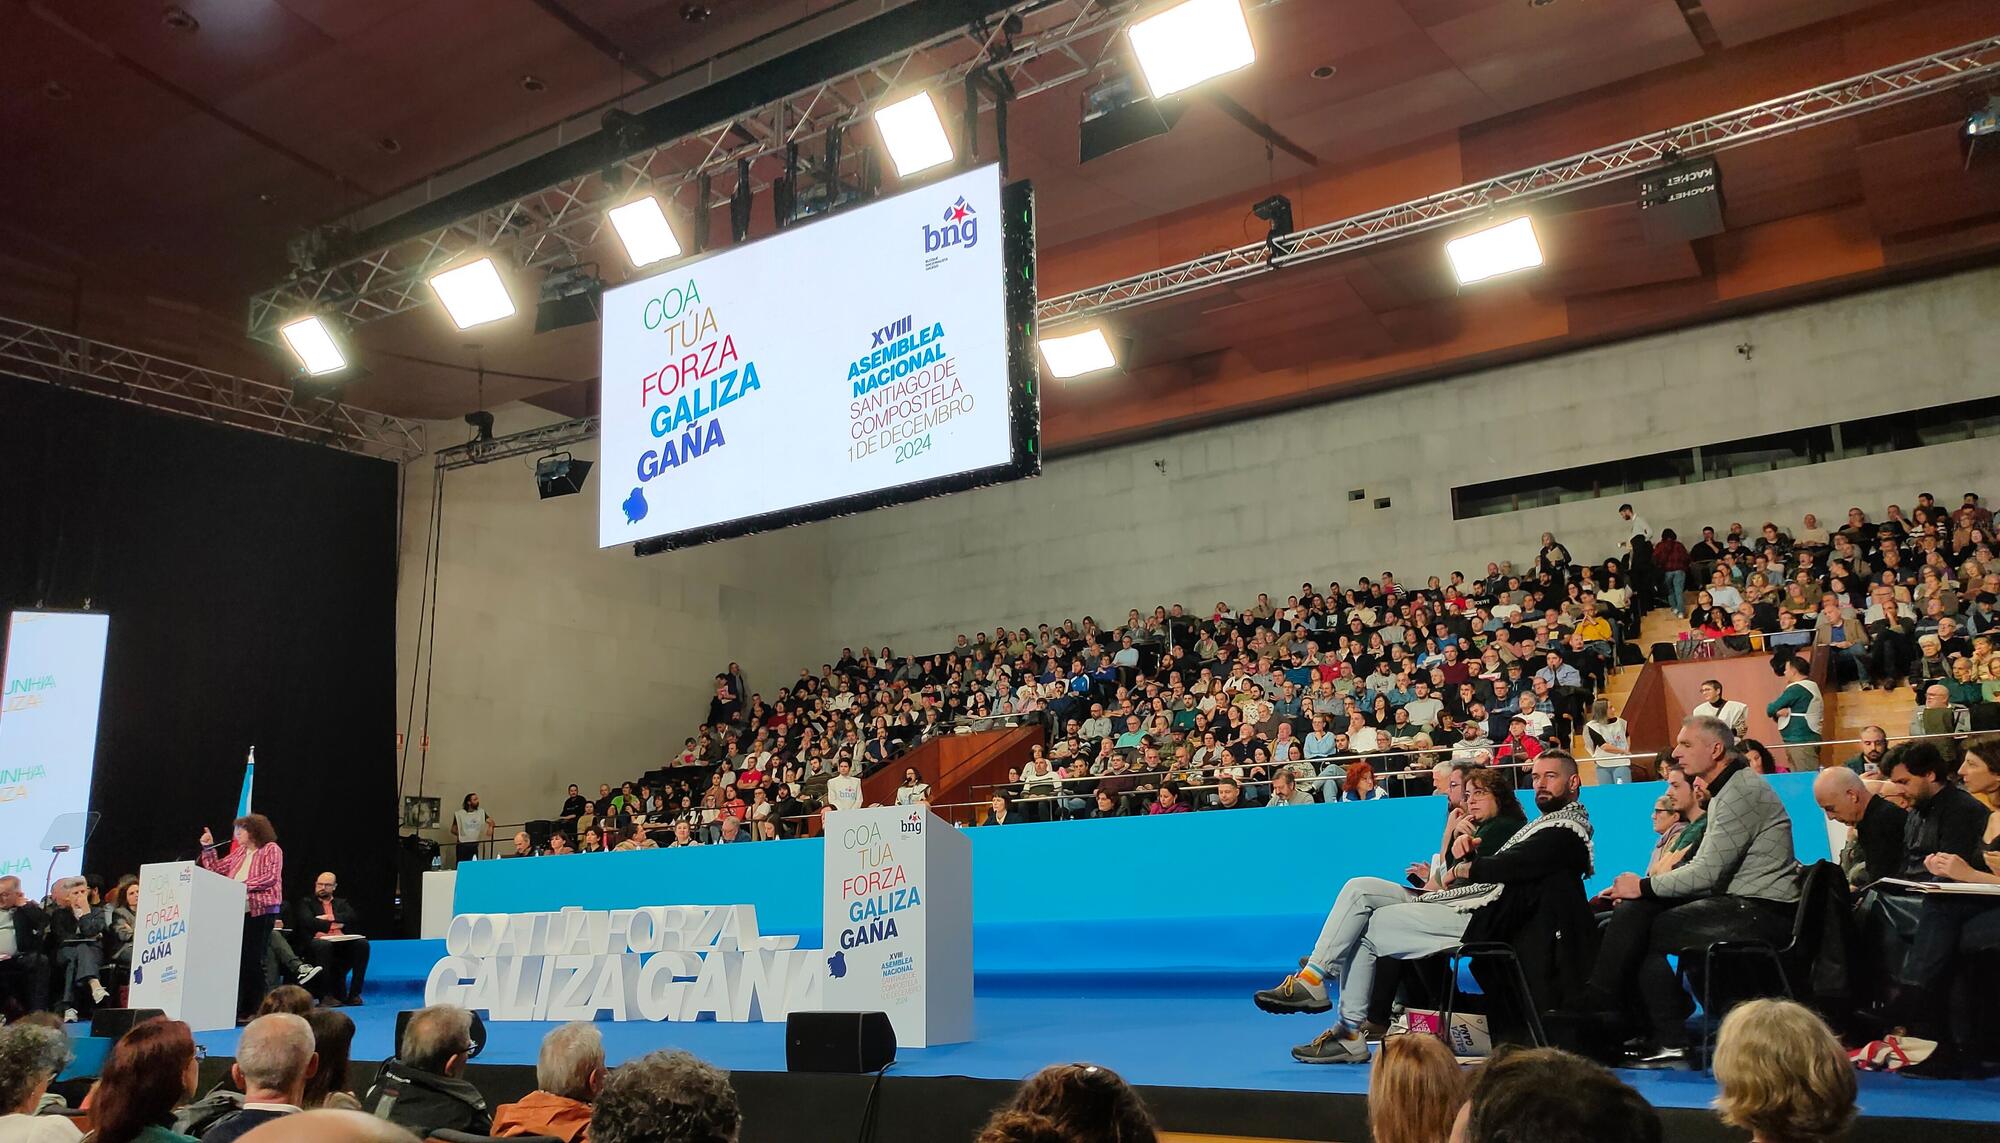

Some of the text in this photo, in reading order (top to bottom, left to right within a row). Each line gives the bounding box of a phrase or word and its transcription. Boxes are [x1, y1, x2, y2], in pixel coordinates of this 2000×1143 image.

[1666, 167, 1713, 187] KACHET
[1668, 184, 1715, 202] KACHET
[922, 217, 978, 253] bng
[643, 278, 701, 330] COA
[664, 306, 718, 356] TÚA
[870, 314, 912, 350] XVIII
[847, 321, 945, 381] ASEMBLEA
[641, 334, 738, 408] FORZA
[850, 357, 957, 420] SANTIAGO DE
[853, 343, 946, 398] NACIONAL
[650, 361, 761, 439] GALIZA
[851, 377, 963, 440] COMPOSTELA
[847, 393, 975, 463] 1 DE DECEMBRO
[637, 418, 726, 483] GAÑA
[895, 433, 932, 464] 2024
[843, 821, 882, 850] COA
[900, 819, 922, 834] bng
[0, 857, 33, 876] NHA
[857, 841, 894, 870] TÚA
[842, 864, 907, 901] FORZA
[145, 904, 180, 929] FORZA
[849, 886, 921, 923] GALIZA
[147, 919, 186, 945] GALIZA
[604, 904, 761, 955] FORZA
[840, 916, 899, 950] GAÑA
[424, 934, 824, 1023] GALIZA GAÑA
[881, 956, 913, 970] ASEMBLEA
[882, 964, 914, 977] NACIONAL
